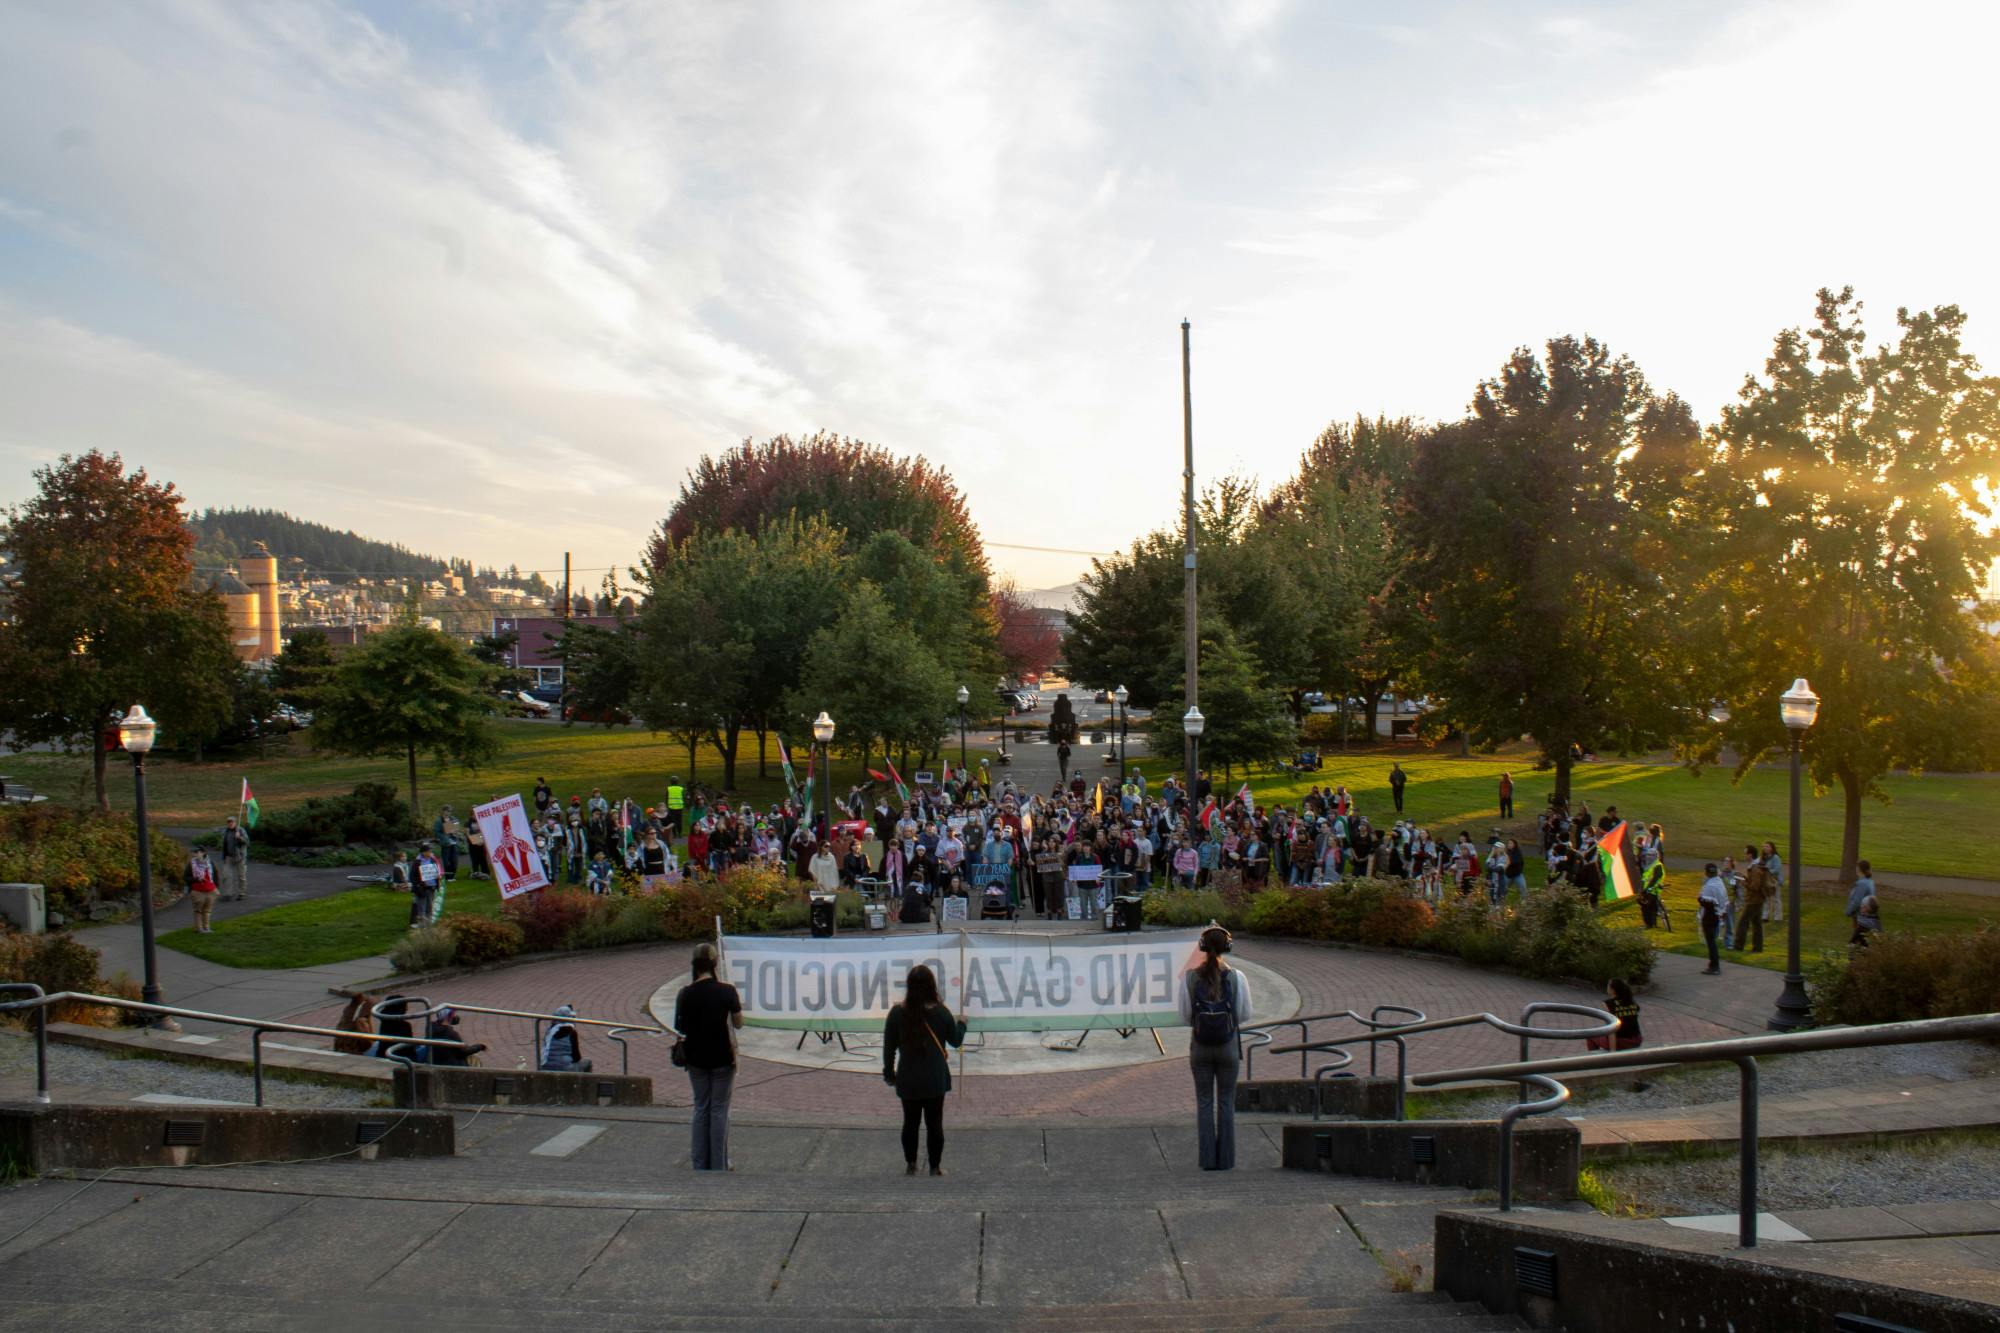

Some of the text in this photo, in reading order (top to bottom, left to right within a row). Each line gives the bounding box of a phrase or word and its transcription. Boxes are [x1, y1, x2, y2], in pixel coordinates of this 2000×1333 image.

[477, 799, 521, 819] FREE PALESTINE
[504, 879, 521, 893] END
